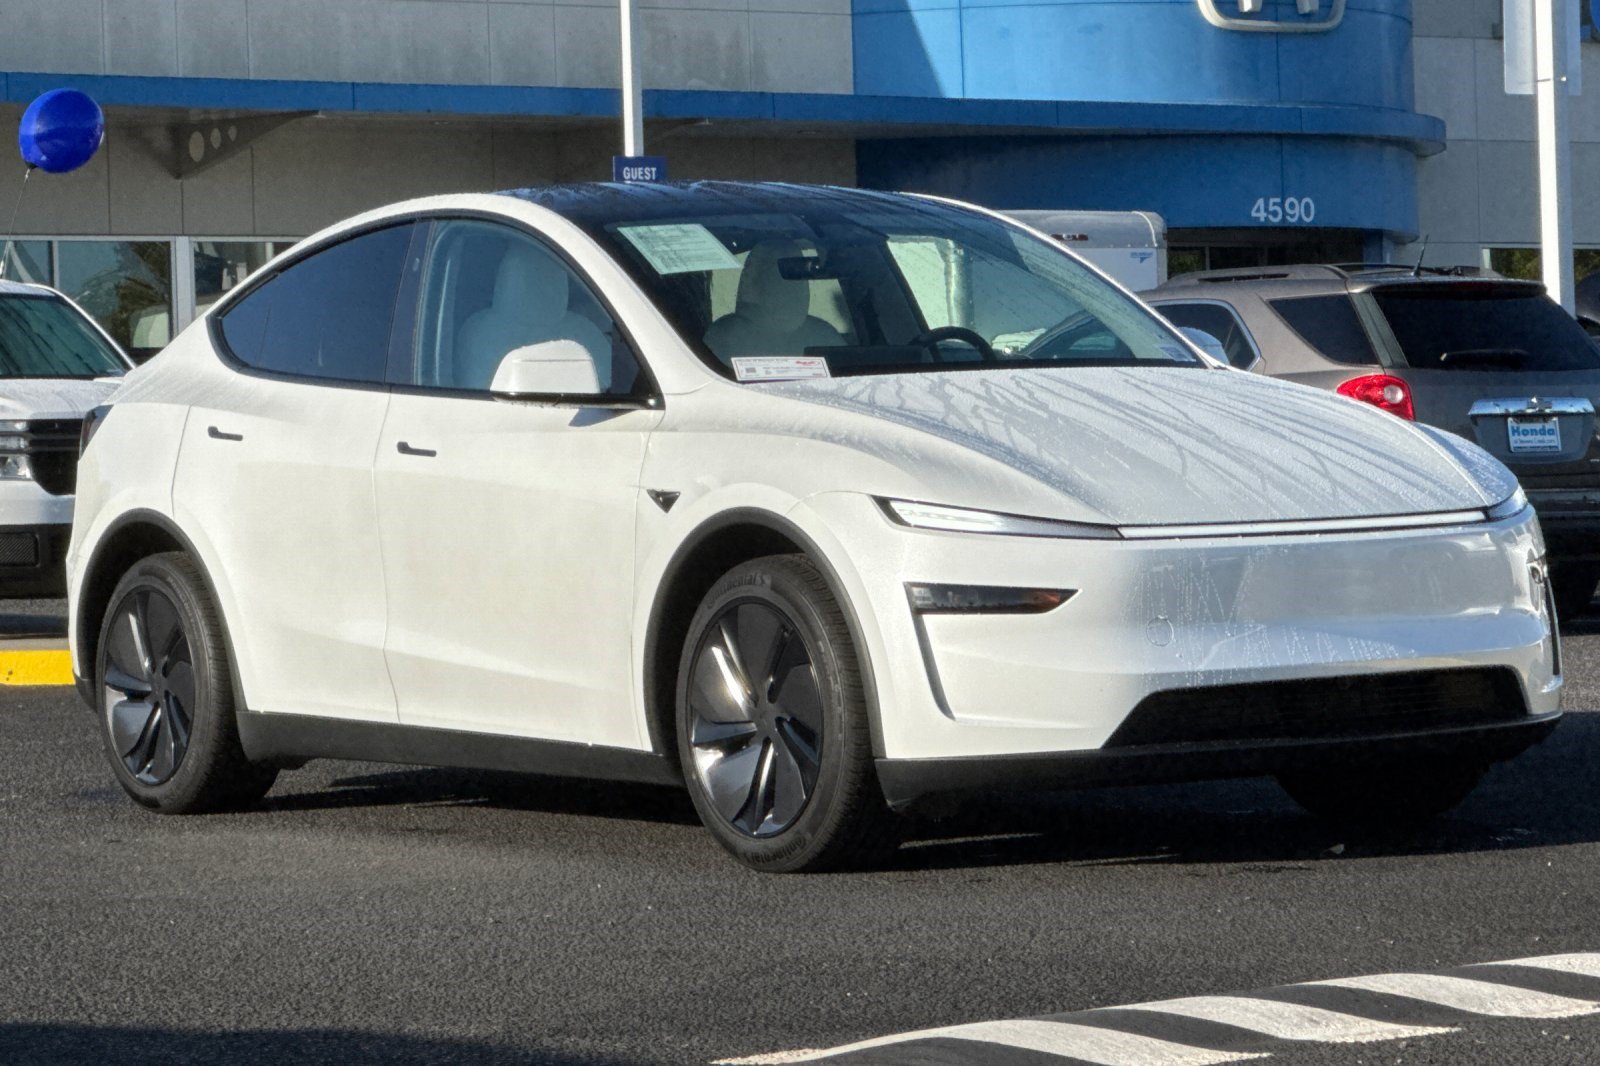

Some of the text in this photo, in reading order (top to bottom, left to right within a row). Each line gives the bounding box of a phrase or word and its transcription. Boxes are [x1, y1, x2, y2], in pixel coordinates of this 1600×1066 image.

[623, 167, 657, 180] GUEST
[1251, 197, 1315, 223] 4590
[1511, 425, 1555, 436] Honda
